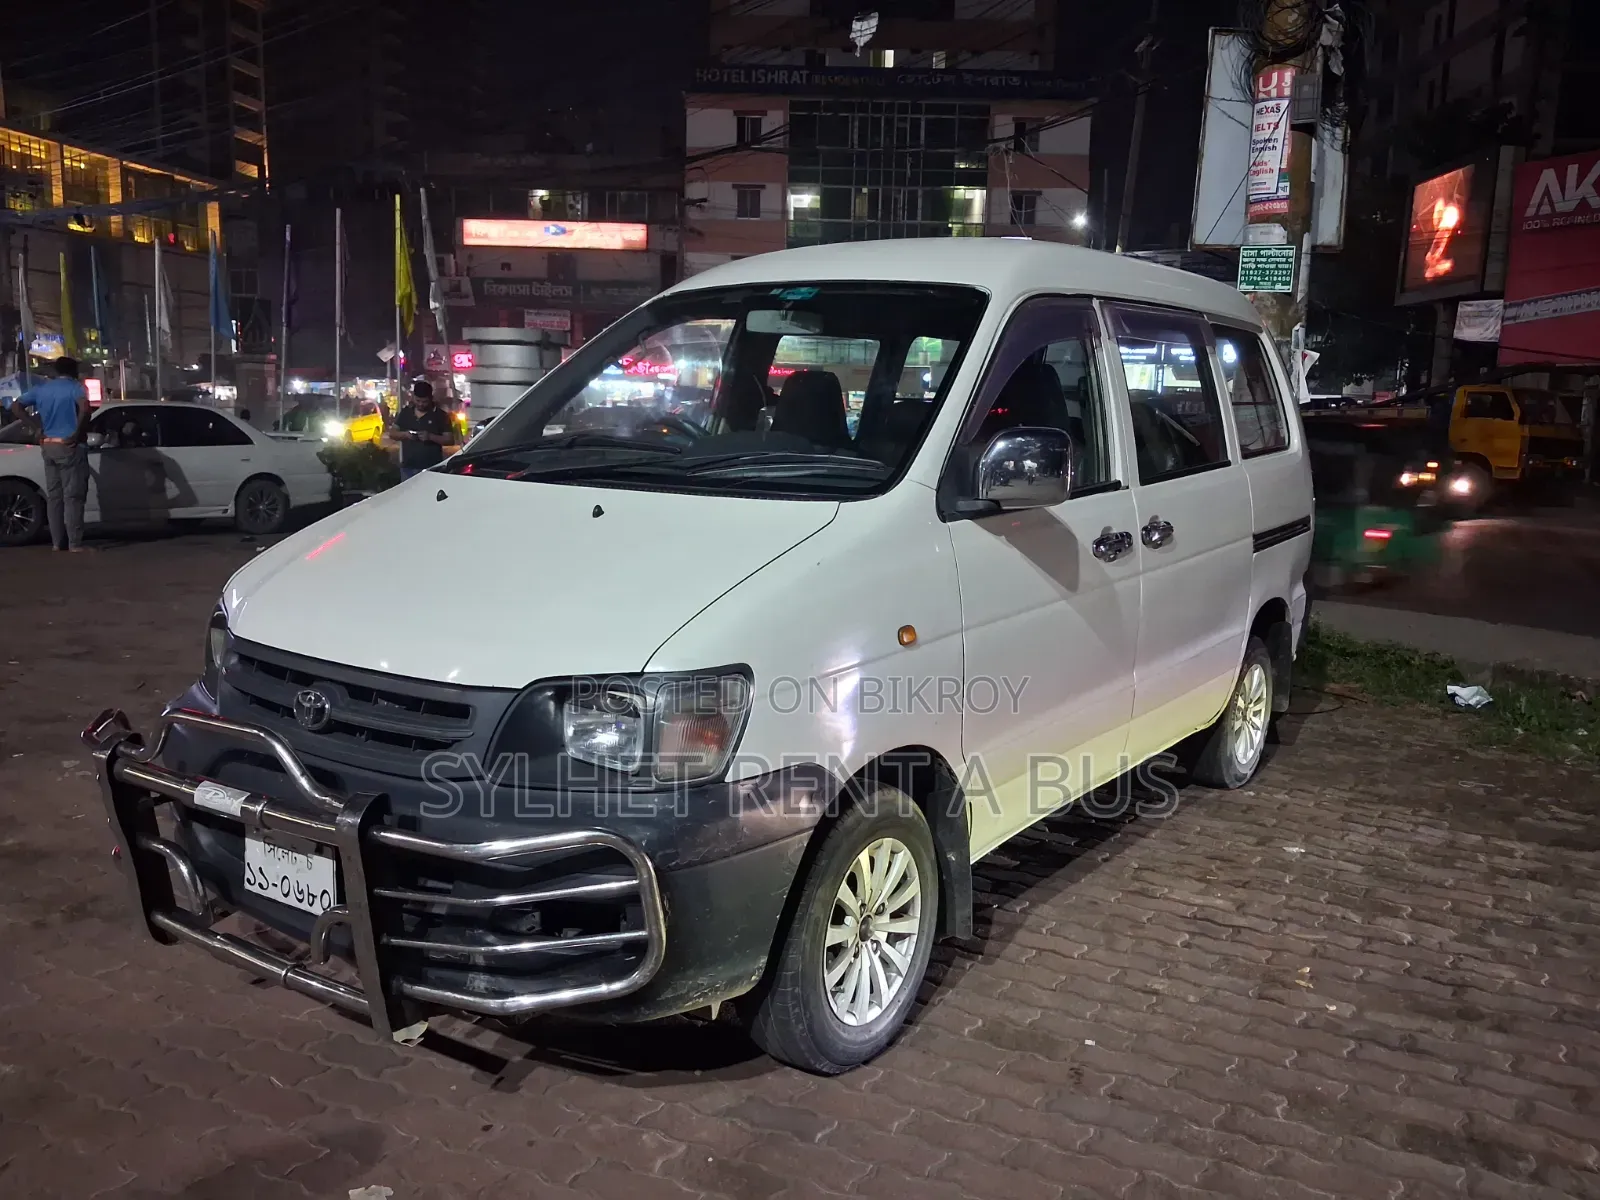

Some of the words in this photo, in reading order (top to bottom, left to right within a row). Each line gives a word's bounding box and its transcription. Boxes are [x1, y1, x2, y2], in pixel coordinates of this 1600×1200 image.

[696, 69, 749, 83] HOTEL
[752, 69, 809, 84] ISHRAT
[1256, 103, 1280, 116] HEXAS
[1255, 121, 1279, 132] IELTS
[1252, 137, 1278, 145] Spoken
[1252, 144, 1277, 153] English
[1249, 168, 1274, 176] English
[246, 861, 332, 911] ১১-০৬৮০
